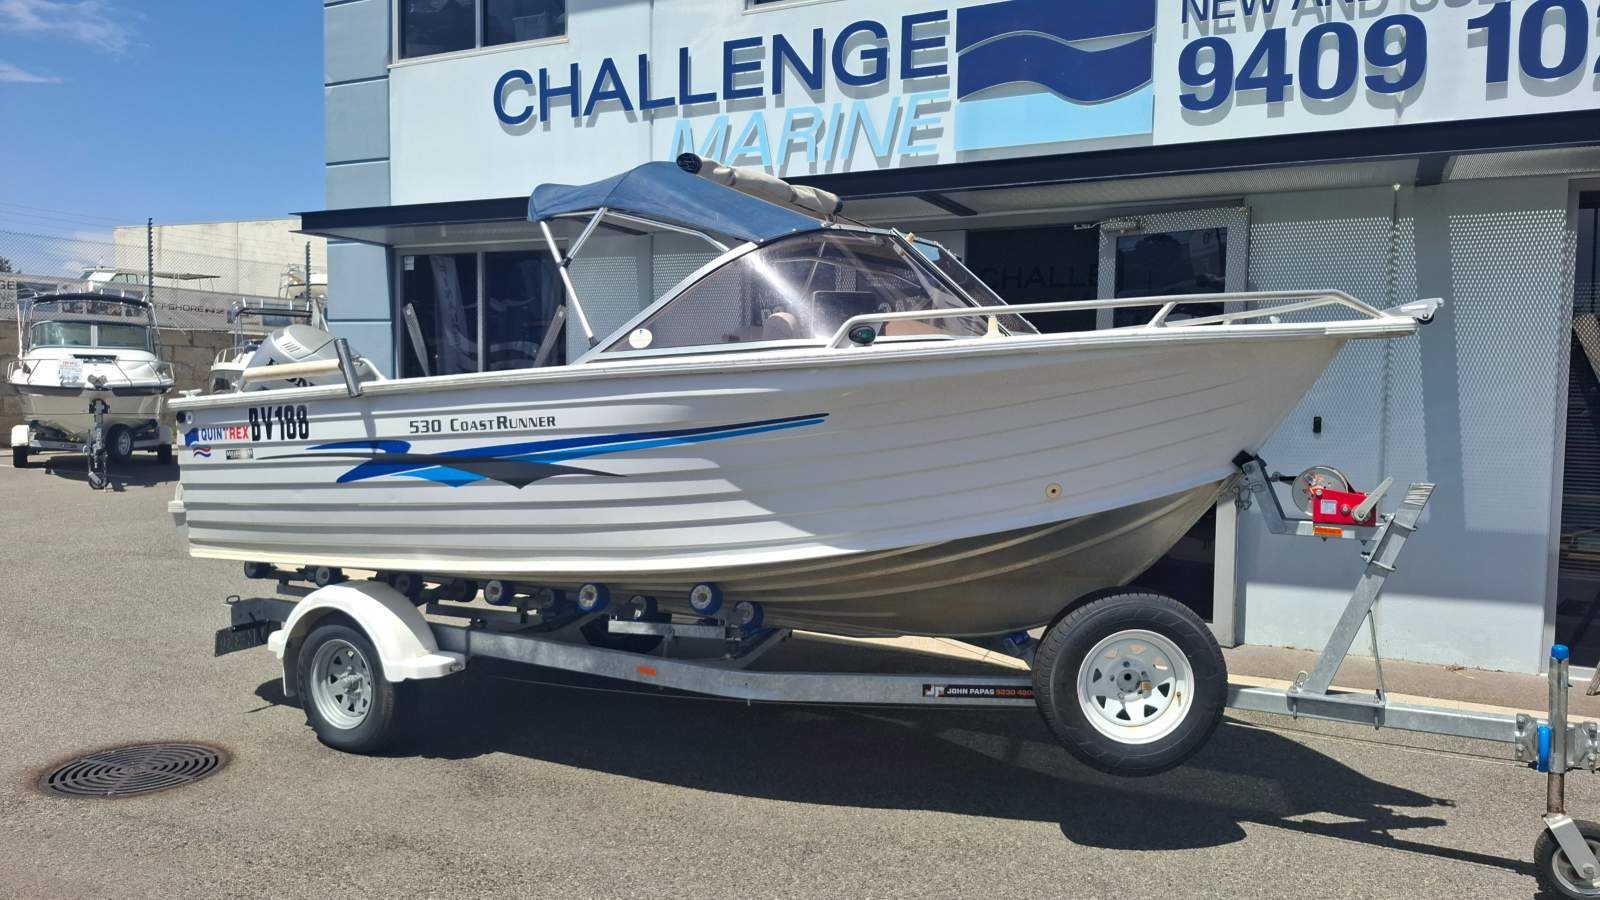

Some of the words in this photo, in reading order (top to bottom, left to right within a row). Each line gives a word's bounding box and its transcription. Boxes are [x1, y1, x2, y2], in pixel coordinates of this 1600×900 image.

[493, 10, 949, 126] CHALLENGE
[1178, 14, 1427, 112] 9409
[1467, 0, 1600, 84] 10
[669, 88, 951, 167] MARINE
[201, 424, 249, 441] QUINTREX
[410, 419, 442, 433] 530
